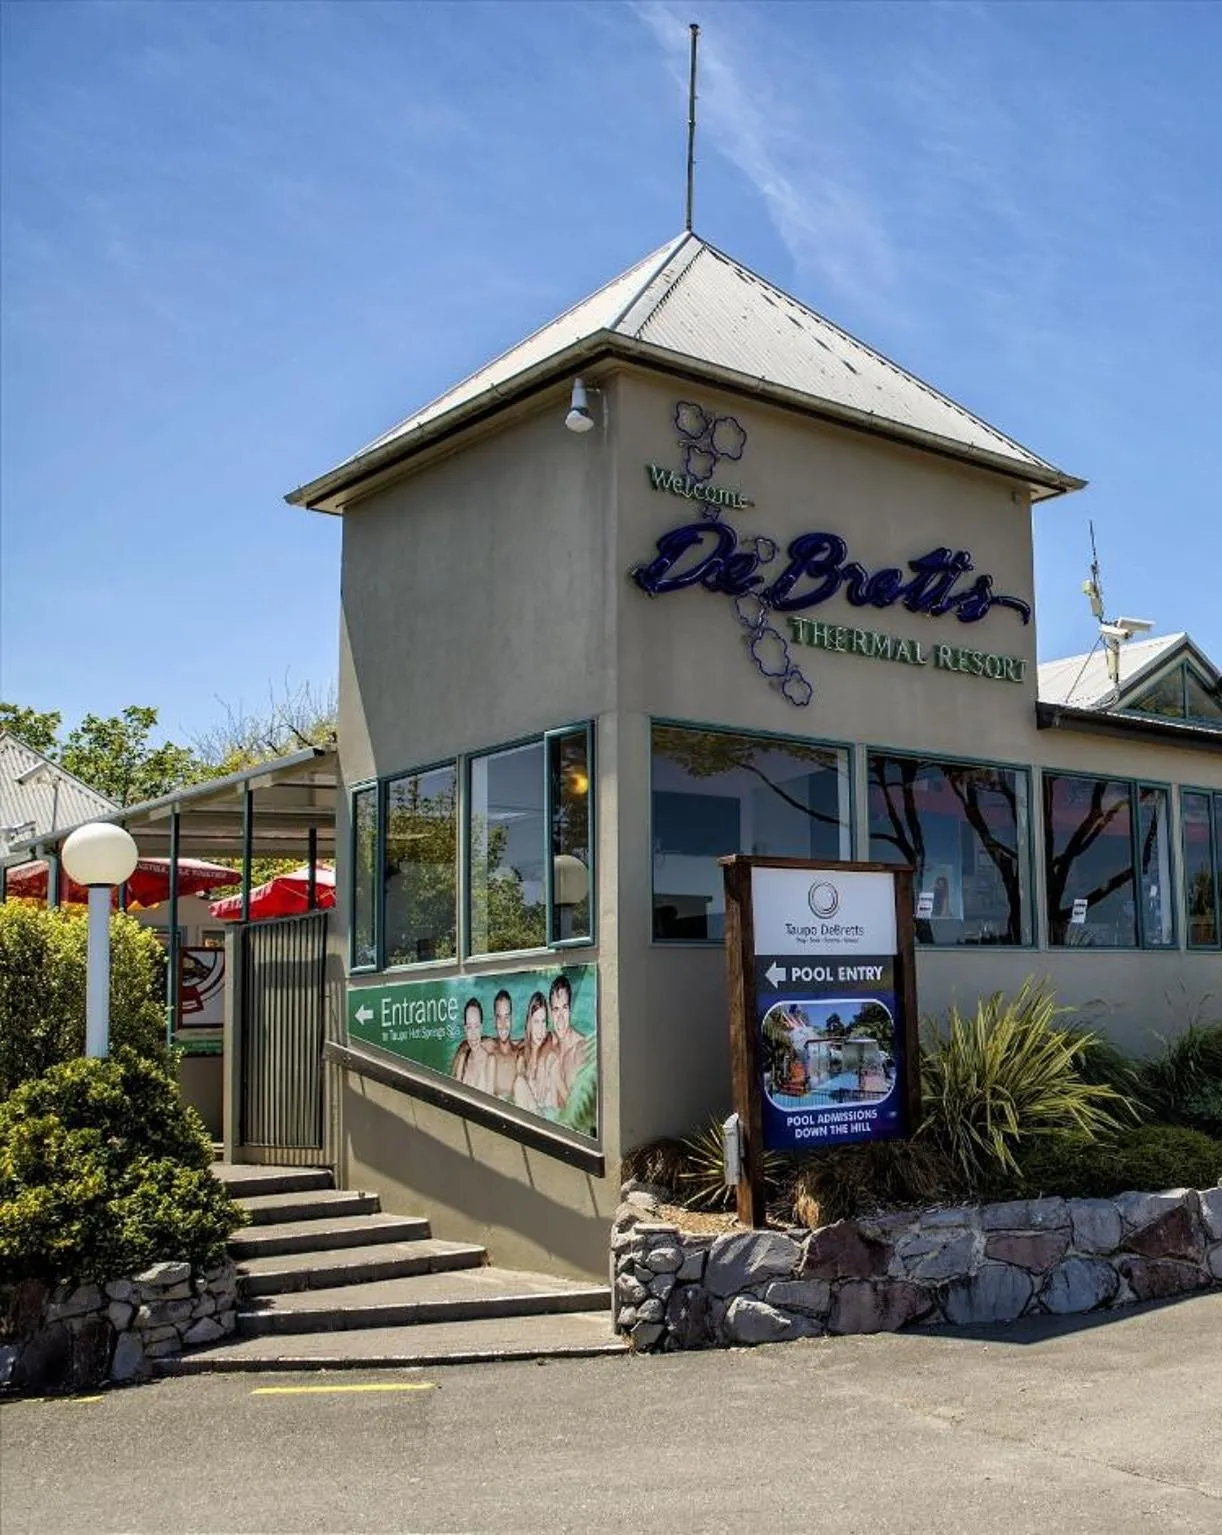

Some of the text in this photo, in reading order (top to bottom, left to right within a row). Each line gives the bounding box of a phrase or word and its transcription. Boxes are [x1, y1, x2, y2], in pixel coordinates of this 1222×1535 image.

[645, 463, 754, 510] Welcome
[630, 521, 765, 597] De
[787, 616, 1028, 684] THERMAL RESORT
[785, 923, 865, 937] Taupo DeBretts
[791, 965, 883, 982] POOL ENTRY
[381, 997, 459, 1027] Entrance
[786, 1109, 878, 1127] POOL ADMISSIONS
[794, 1121, 871, 1138] DOWN THE HILL
